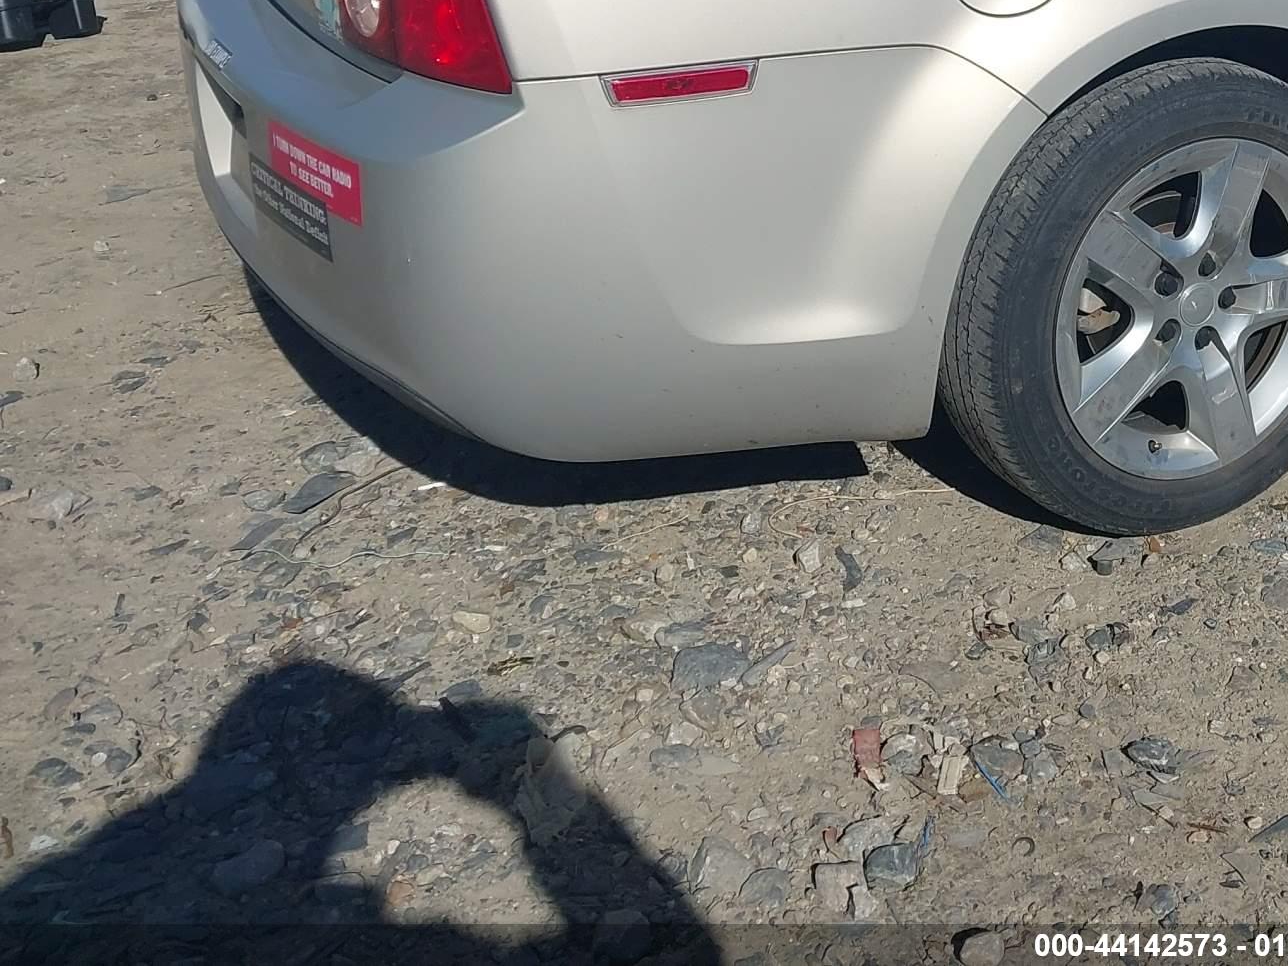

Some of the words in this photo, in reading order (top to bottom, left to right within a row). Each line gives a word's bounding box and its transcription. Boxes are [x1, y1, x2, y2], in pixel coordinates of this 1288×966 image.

[298, 166, 311, 185] SEE
[306, 153, 319, 172] THE
[318, 160, 332, 179] CAR
